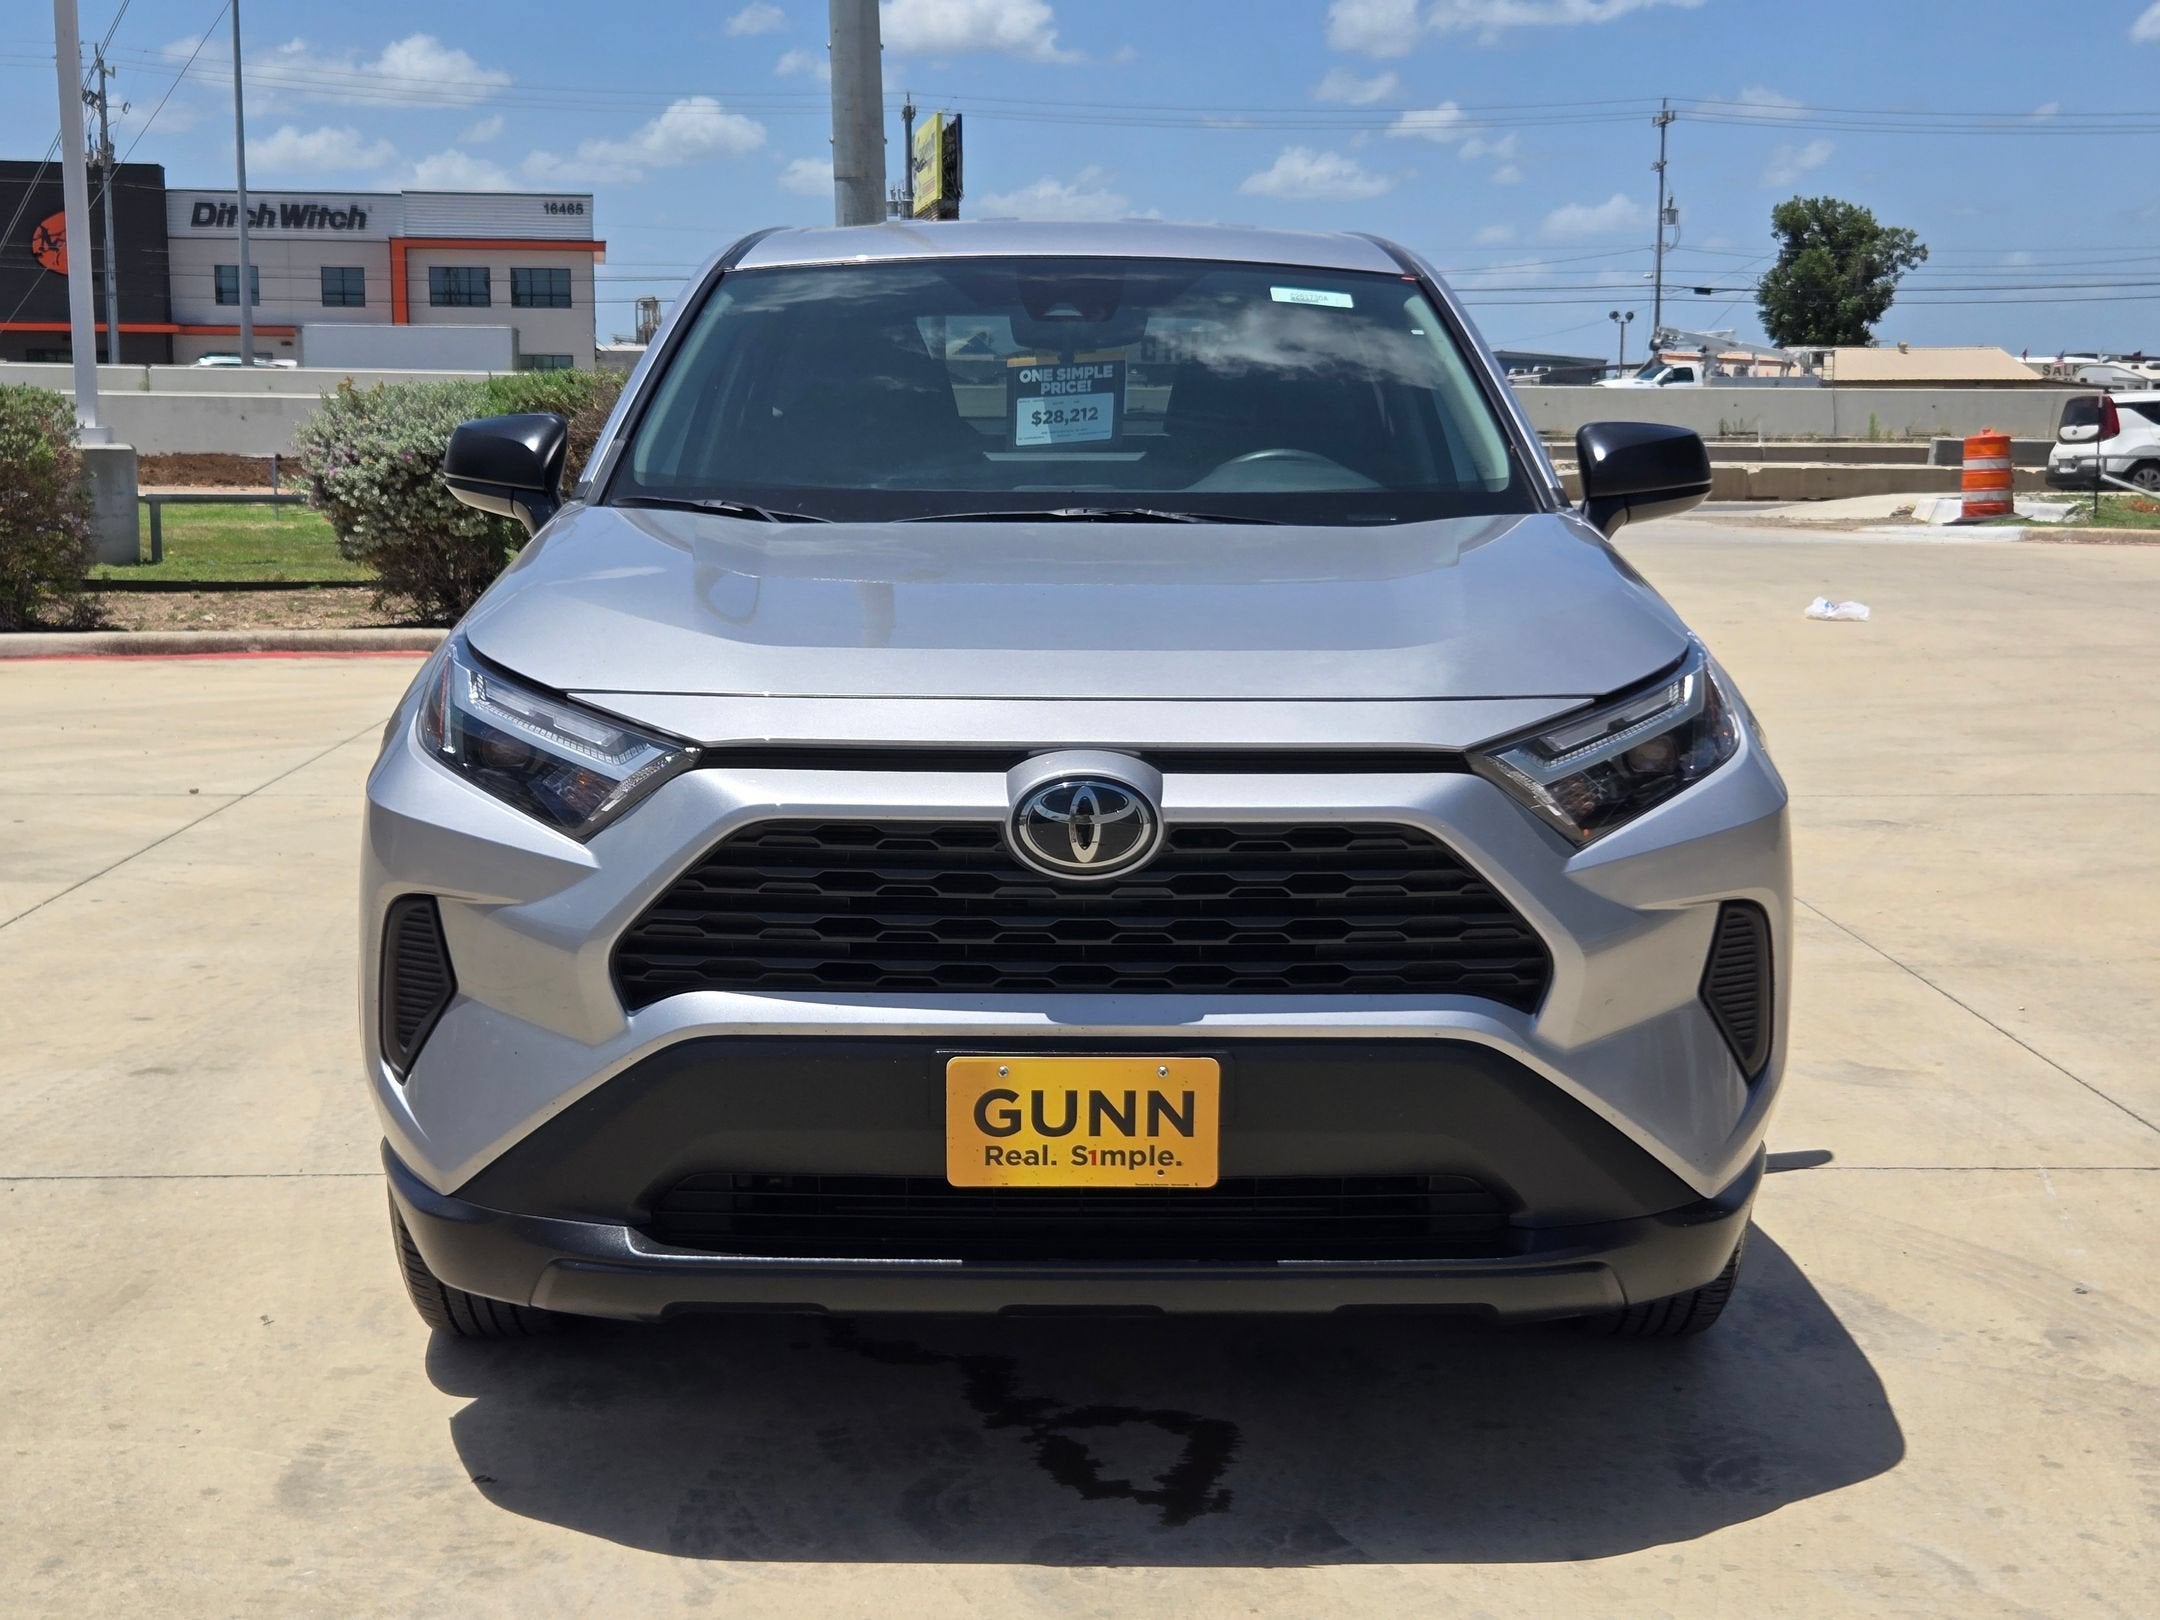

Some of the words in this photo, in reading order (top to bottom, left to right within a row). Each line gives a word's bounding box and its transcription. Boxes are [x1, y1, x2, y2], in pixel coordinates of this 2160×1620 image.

[190, 202, 277, 228] Ditch
[279, 203, 368, 230] Witch
[543, 202, 585, 215] 16465
[1019, 368, 1053, 383] ONE
[1056, 365, 1113, 381] SIMPLE
[1040, 380, 1092, 395] PRICE!
[1031, 407, 1098, 426] $28,212
[973, 1088, 1195, 1138] GUNN
[984, 1144, 1057, 1167] Real.
